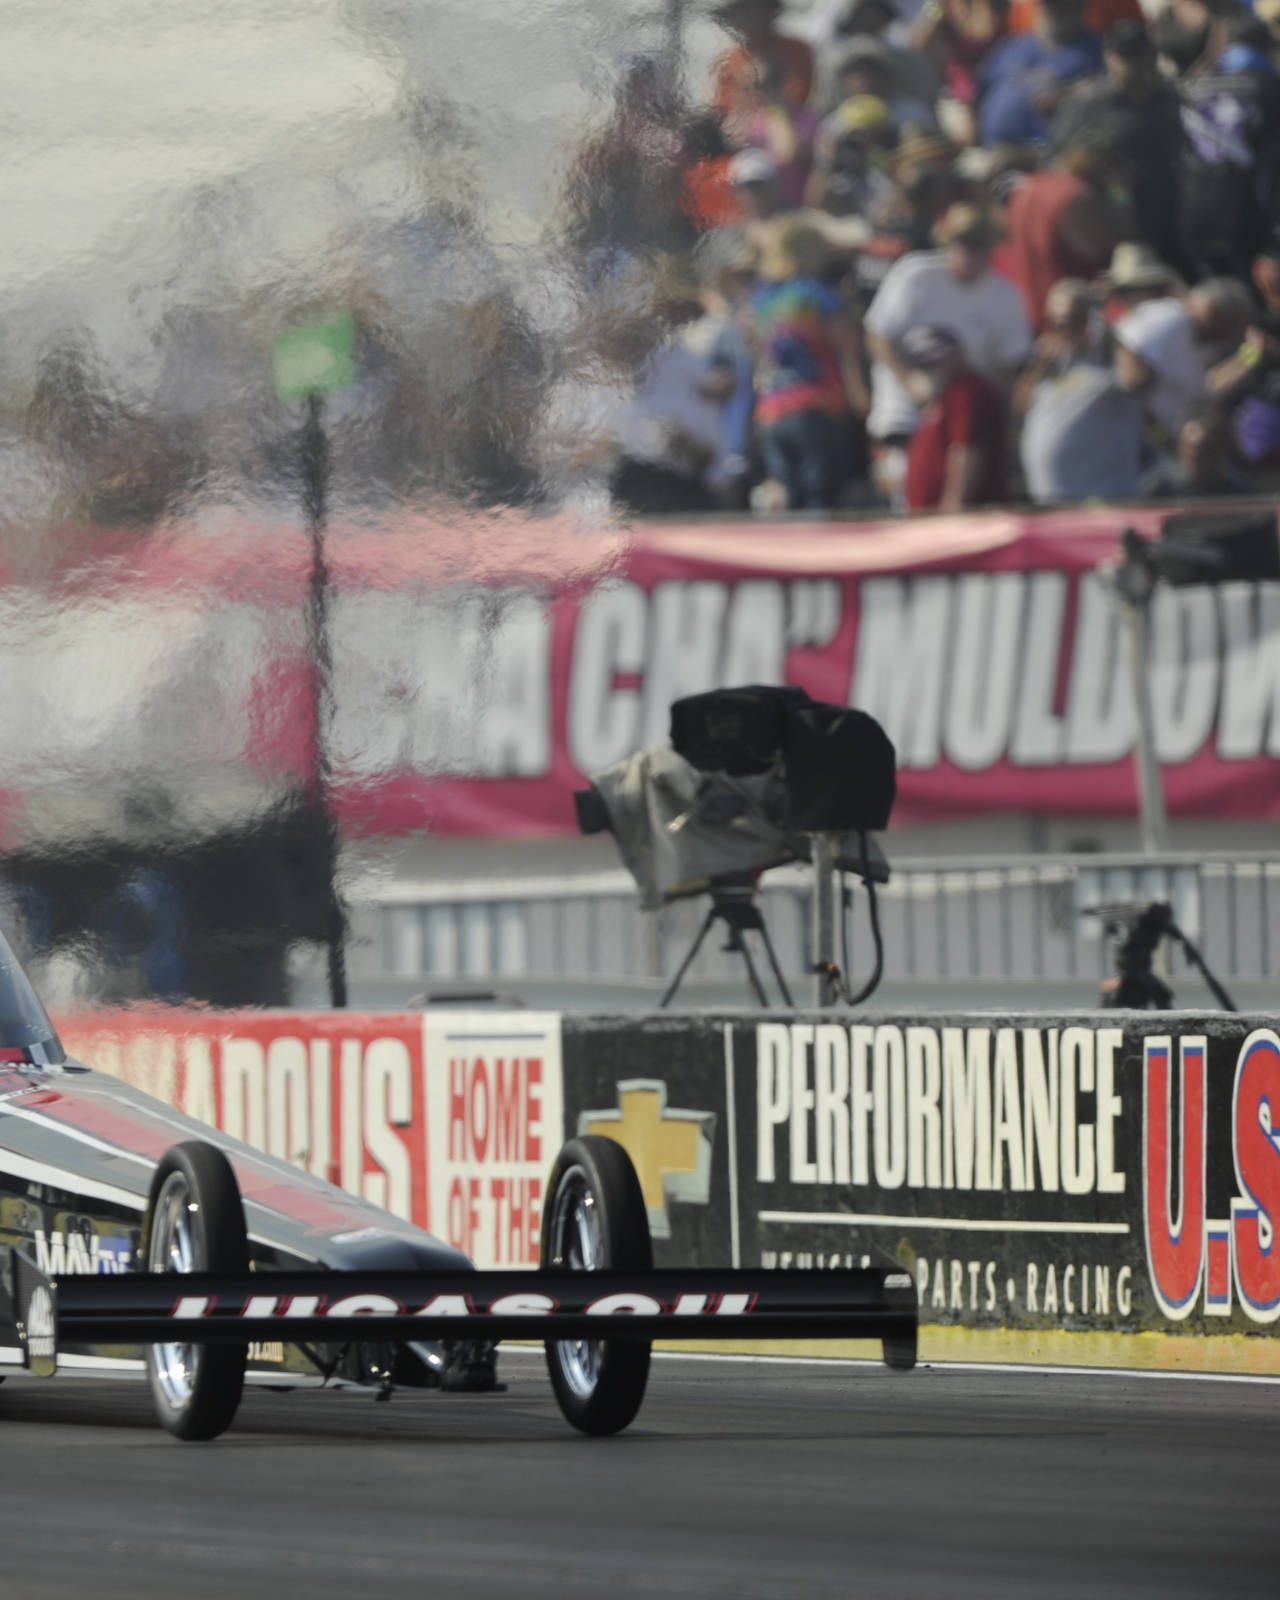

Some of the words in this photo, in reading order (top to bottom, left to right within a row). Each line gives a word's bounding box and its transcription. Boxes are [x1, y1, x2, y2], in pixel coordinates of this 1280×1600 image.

[448, 1057, 542, 1163] HOME
[756, 1022, 1126, 1195] PERFORMANCE
[448, 1176, 480, 1260] OF
[491, 1177, 541, 1264] THE
[917, 1257, 997, 1311] PARTS
[1026, 1262, 1132, 1316] RACING
